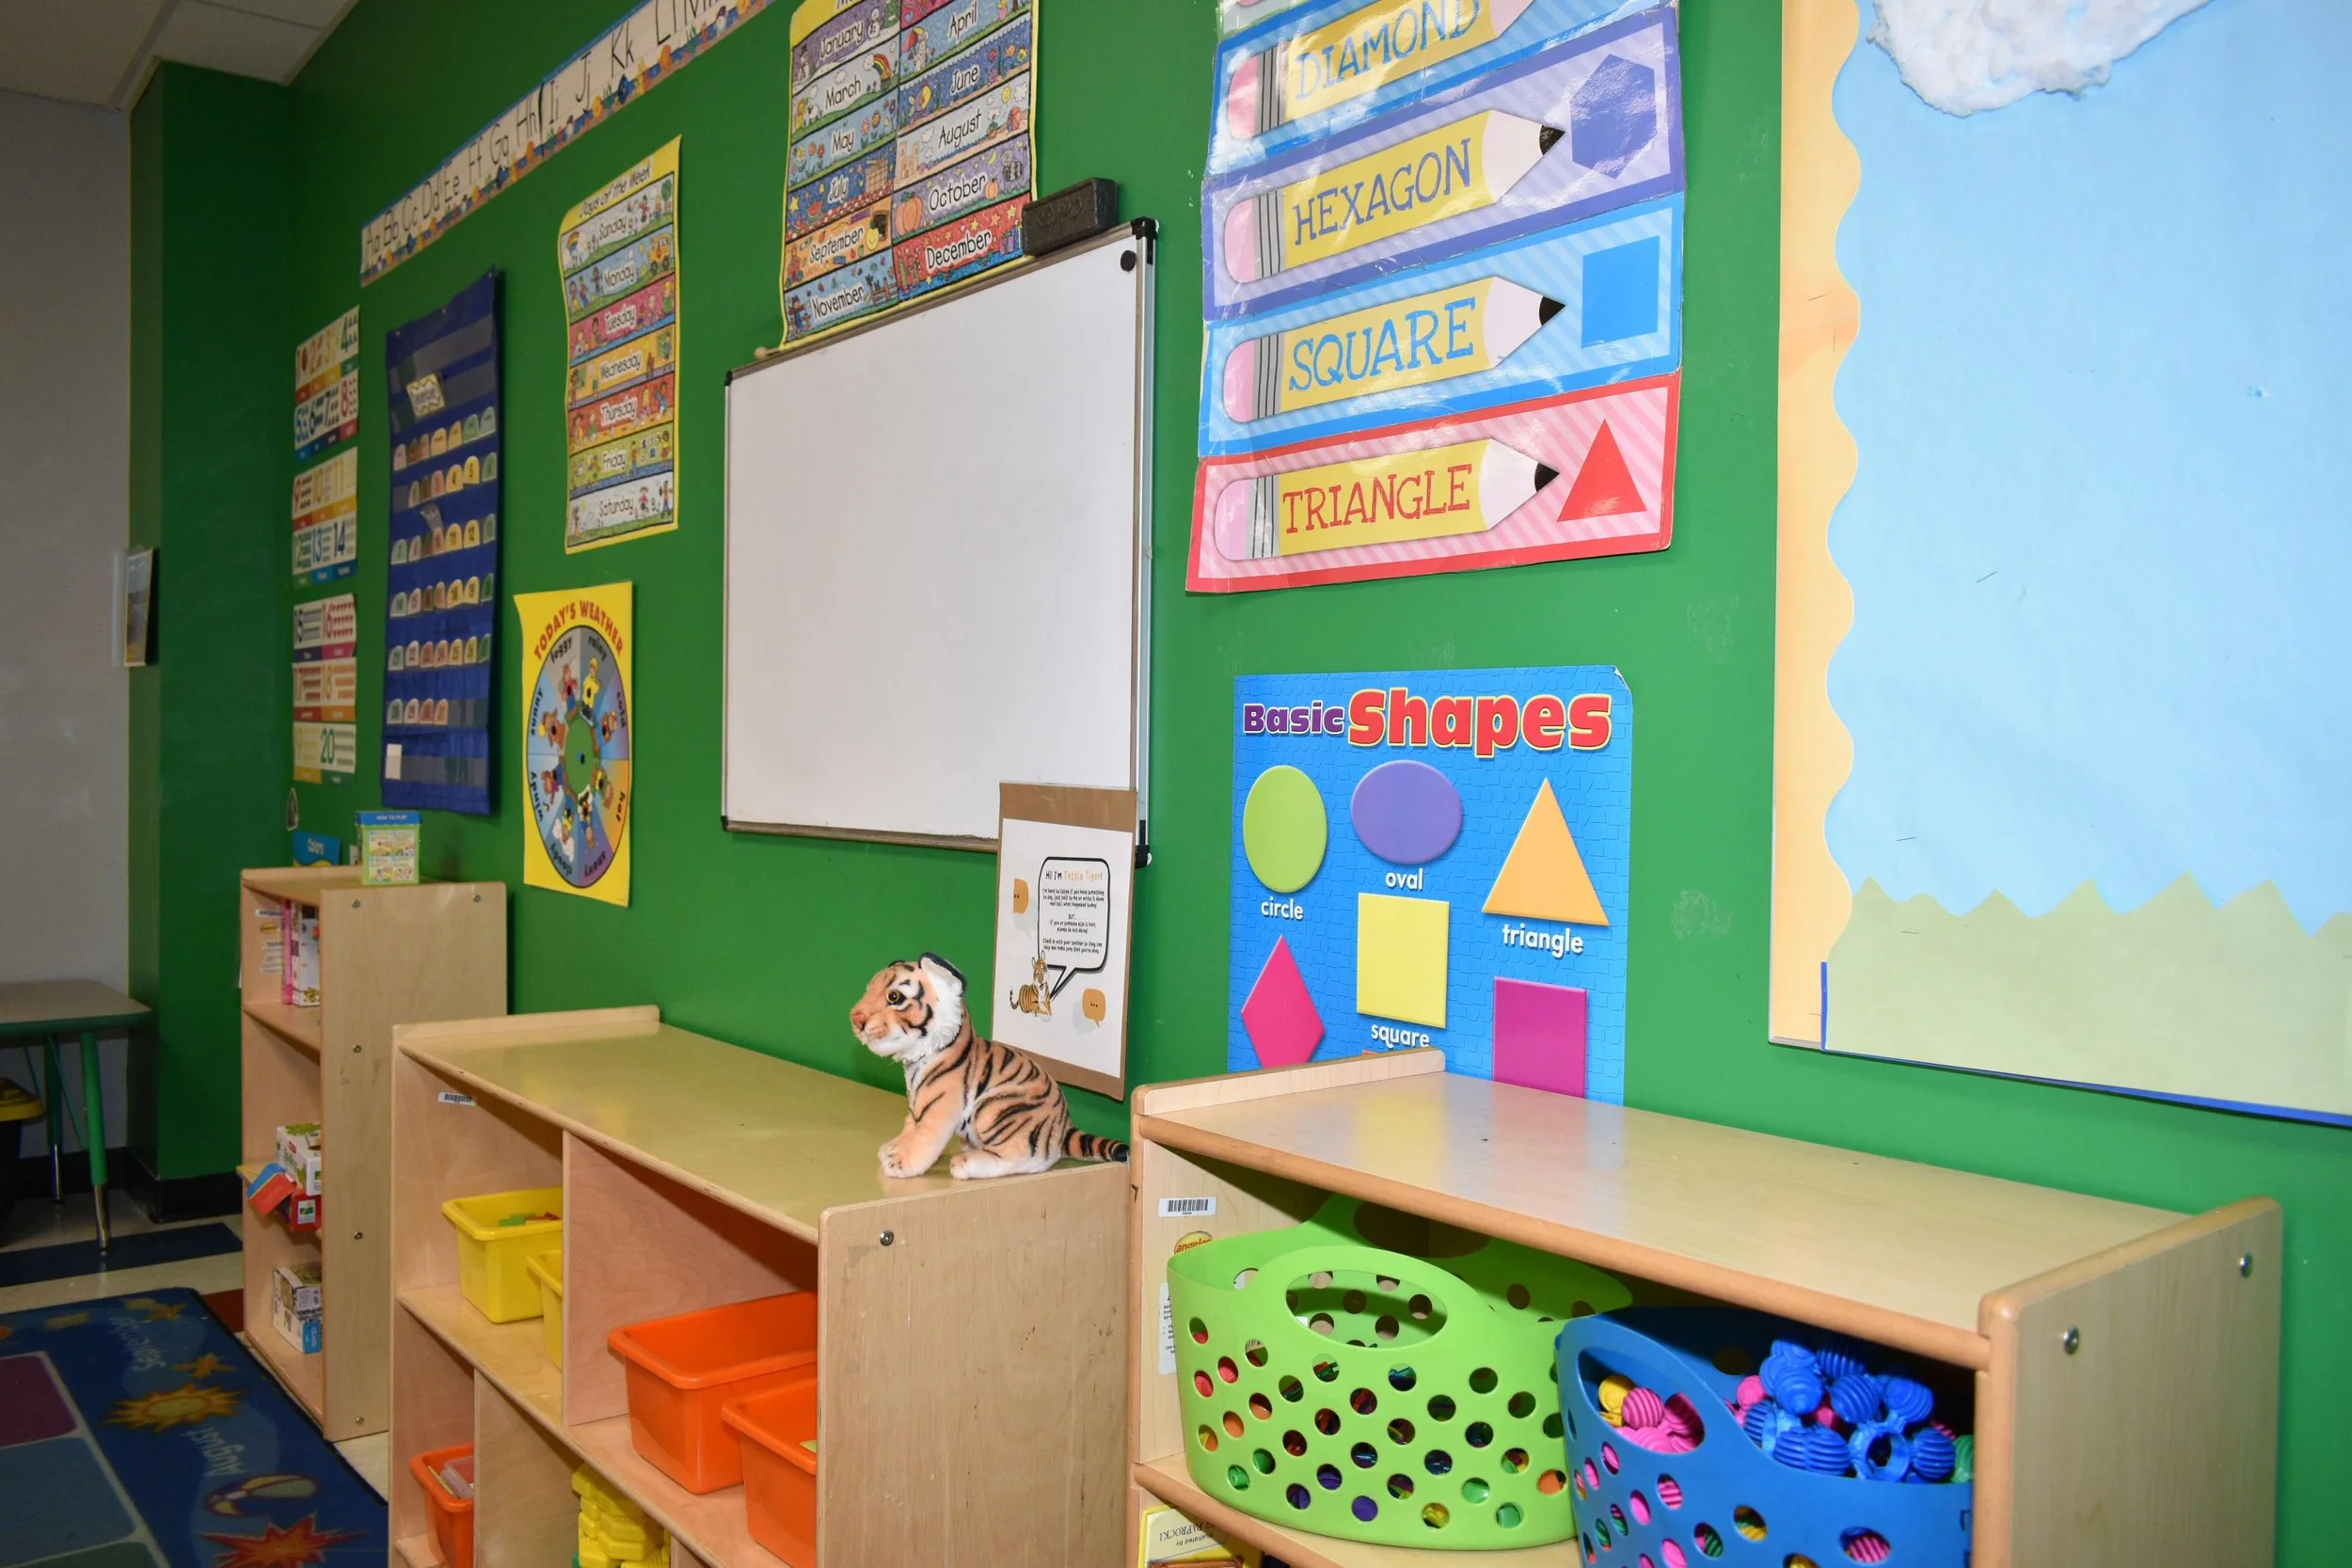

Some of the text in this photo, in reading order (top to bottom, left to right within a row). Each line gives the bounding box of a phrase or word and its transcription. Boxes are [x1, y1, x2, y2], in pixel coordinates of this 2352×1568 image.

[949, 6, 978, 40] April
[819, 21, 864, 60] January
[1295, 0, 1481, 101] DIAMOND
[825, 76, 861, 107] March
[951, 67, 979, 95] June
[384, 210, 399, 247] Bb
[403, 195, 418, 232] Cc
[444, 160, 460, 202] Ee
[489, 123, 510, 166] Gg
[516, 98, 538, 147] Hh
[549, 80, 560, 125] Ii
[575, 52, 592, 114] Jj
[612, 21, 635, 79] Kk
[832, 129, 854, 153] May
[937, 112, 982, 150] August
[579, 198, 599, 218] Days
[629, 159, 651, 188] Week
[829, 177, 849, 203] July
[928, 175, 988, 212] October
[1293, 137, 1472, 246] HEXAGON
[599, 214, 627, 241] Sunday
[809, 227, 865, 264] September
[926, 230, 992, 269] December
[604, 259, 634, 290] Monday
[604, 306, 636, 335] Tuesday
[811, 287, 865, 320] November
[341, 317, 349, 353] 4
[1289, 296, 1476, 392] SQUARE
[599, 356, 643, 383] Wednesday
[341, 379, 349, 418] 8
[600, 395, 637, 425] Thursday
[602, 448, 626, 471] Friday
[598, 492, 634, 519] Saturday
[1282, 464, 1472, 534] TRIANGLE
[333, 520, 345, 558] 14
[533, 600, 624, 660] TODAY'S WEATHER
[549, 636, 573, 664] foggy
[530, 687, 544, 736] sunny
[1243, 687, 1613, 759] Basic Shapes
[321, 727, 335, 765] 20
[530, 771, 544, 822] windy
[615, 791, 627, 823] hot
[584, 850, 607, 877] snowy
[1385, 868, 1423, 892] oval
[1261, 898, 1304, 921] circle
[1502, 923, 1584, 958] triangle
[1371, 1023, 1430, 1049] square
[1176, 1237, 1211, 1254] angel
[181, 1426, 247, 1478] August
[1159, 1523, 1203, 1542] PAPROCKI
[1175, 1533, 1214, 1547] ustrated by
